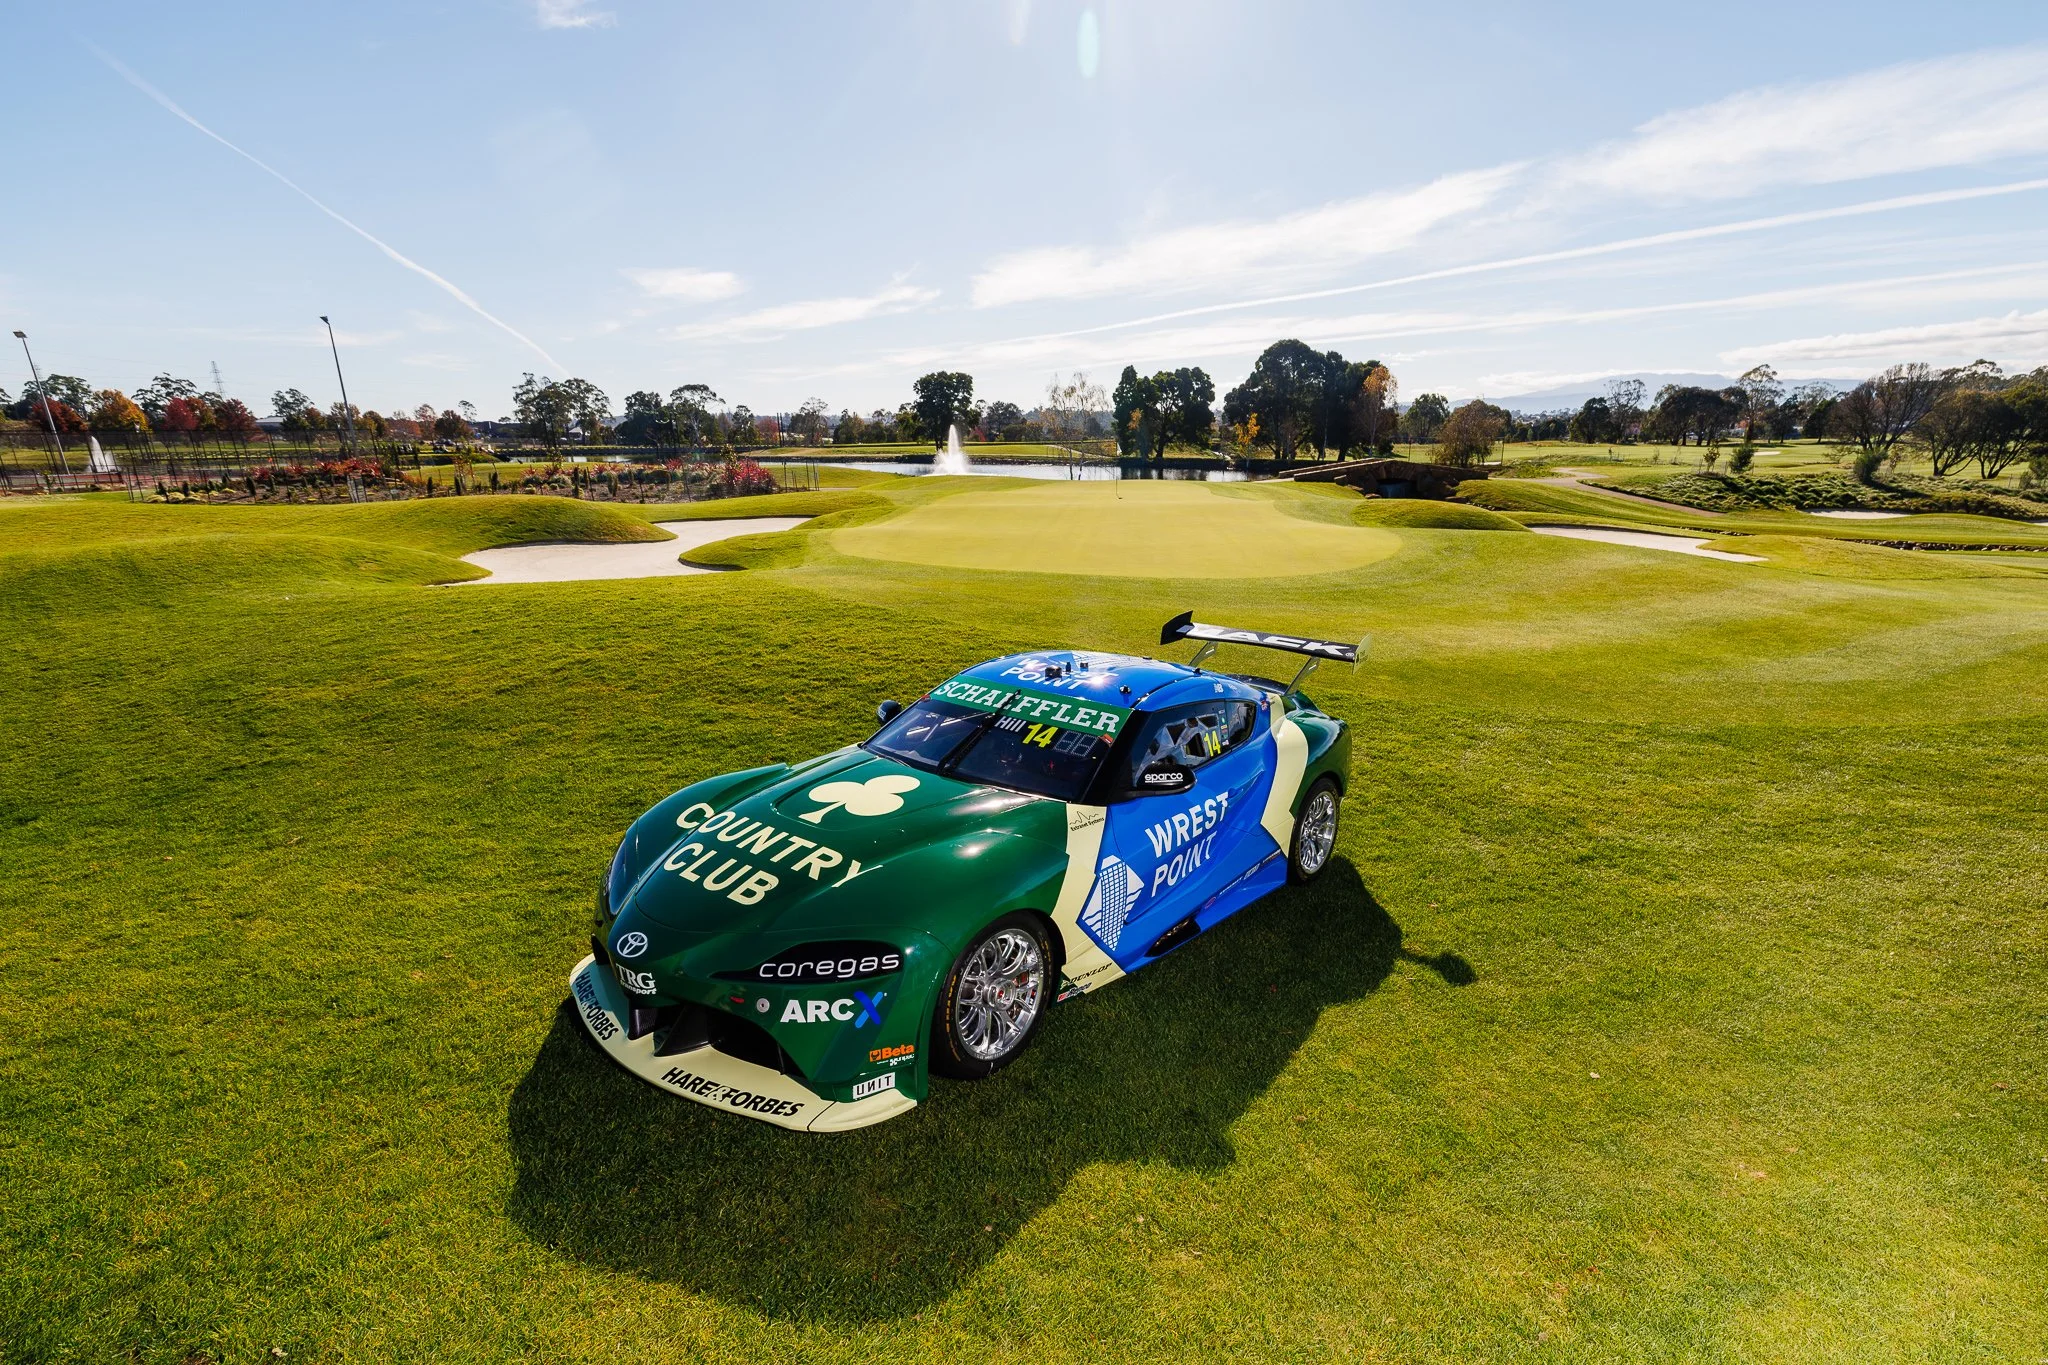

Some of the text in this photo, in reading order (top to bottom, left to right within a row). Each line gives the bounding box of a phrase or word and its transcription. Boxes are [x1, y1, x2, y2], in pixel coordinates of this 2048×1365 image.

[1000, 666, 1084, 690] POINT
[933, 681, 1120, 733] SCHAEFFLER
[994, 716, 1026, 733] Hill
[1022, 723, 1059, 748] 14
[1203, 730, 1221, 757] 14
[1144, 772, 1184, 783] sparco
[1144, 791, 1229, 859] WREST
[676, 802, 884, 888] COUNTRY
[663, 842, 780, 906] CLUB
[1151, 830, 1218, 898] POINT
[615, 962, 656, 990] TRG
[759, 954, 900, 978] coregas
[1070, 962, 1113, 983] DUNLOP
[881, 1044, 914, 1060] Beta
[660, 1066, 805, 1117] HARE&FORBES
